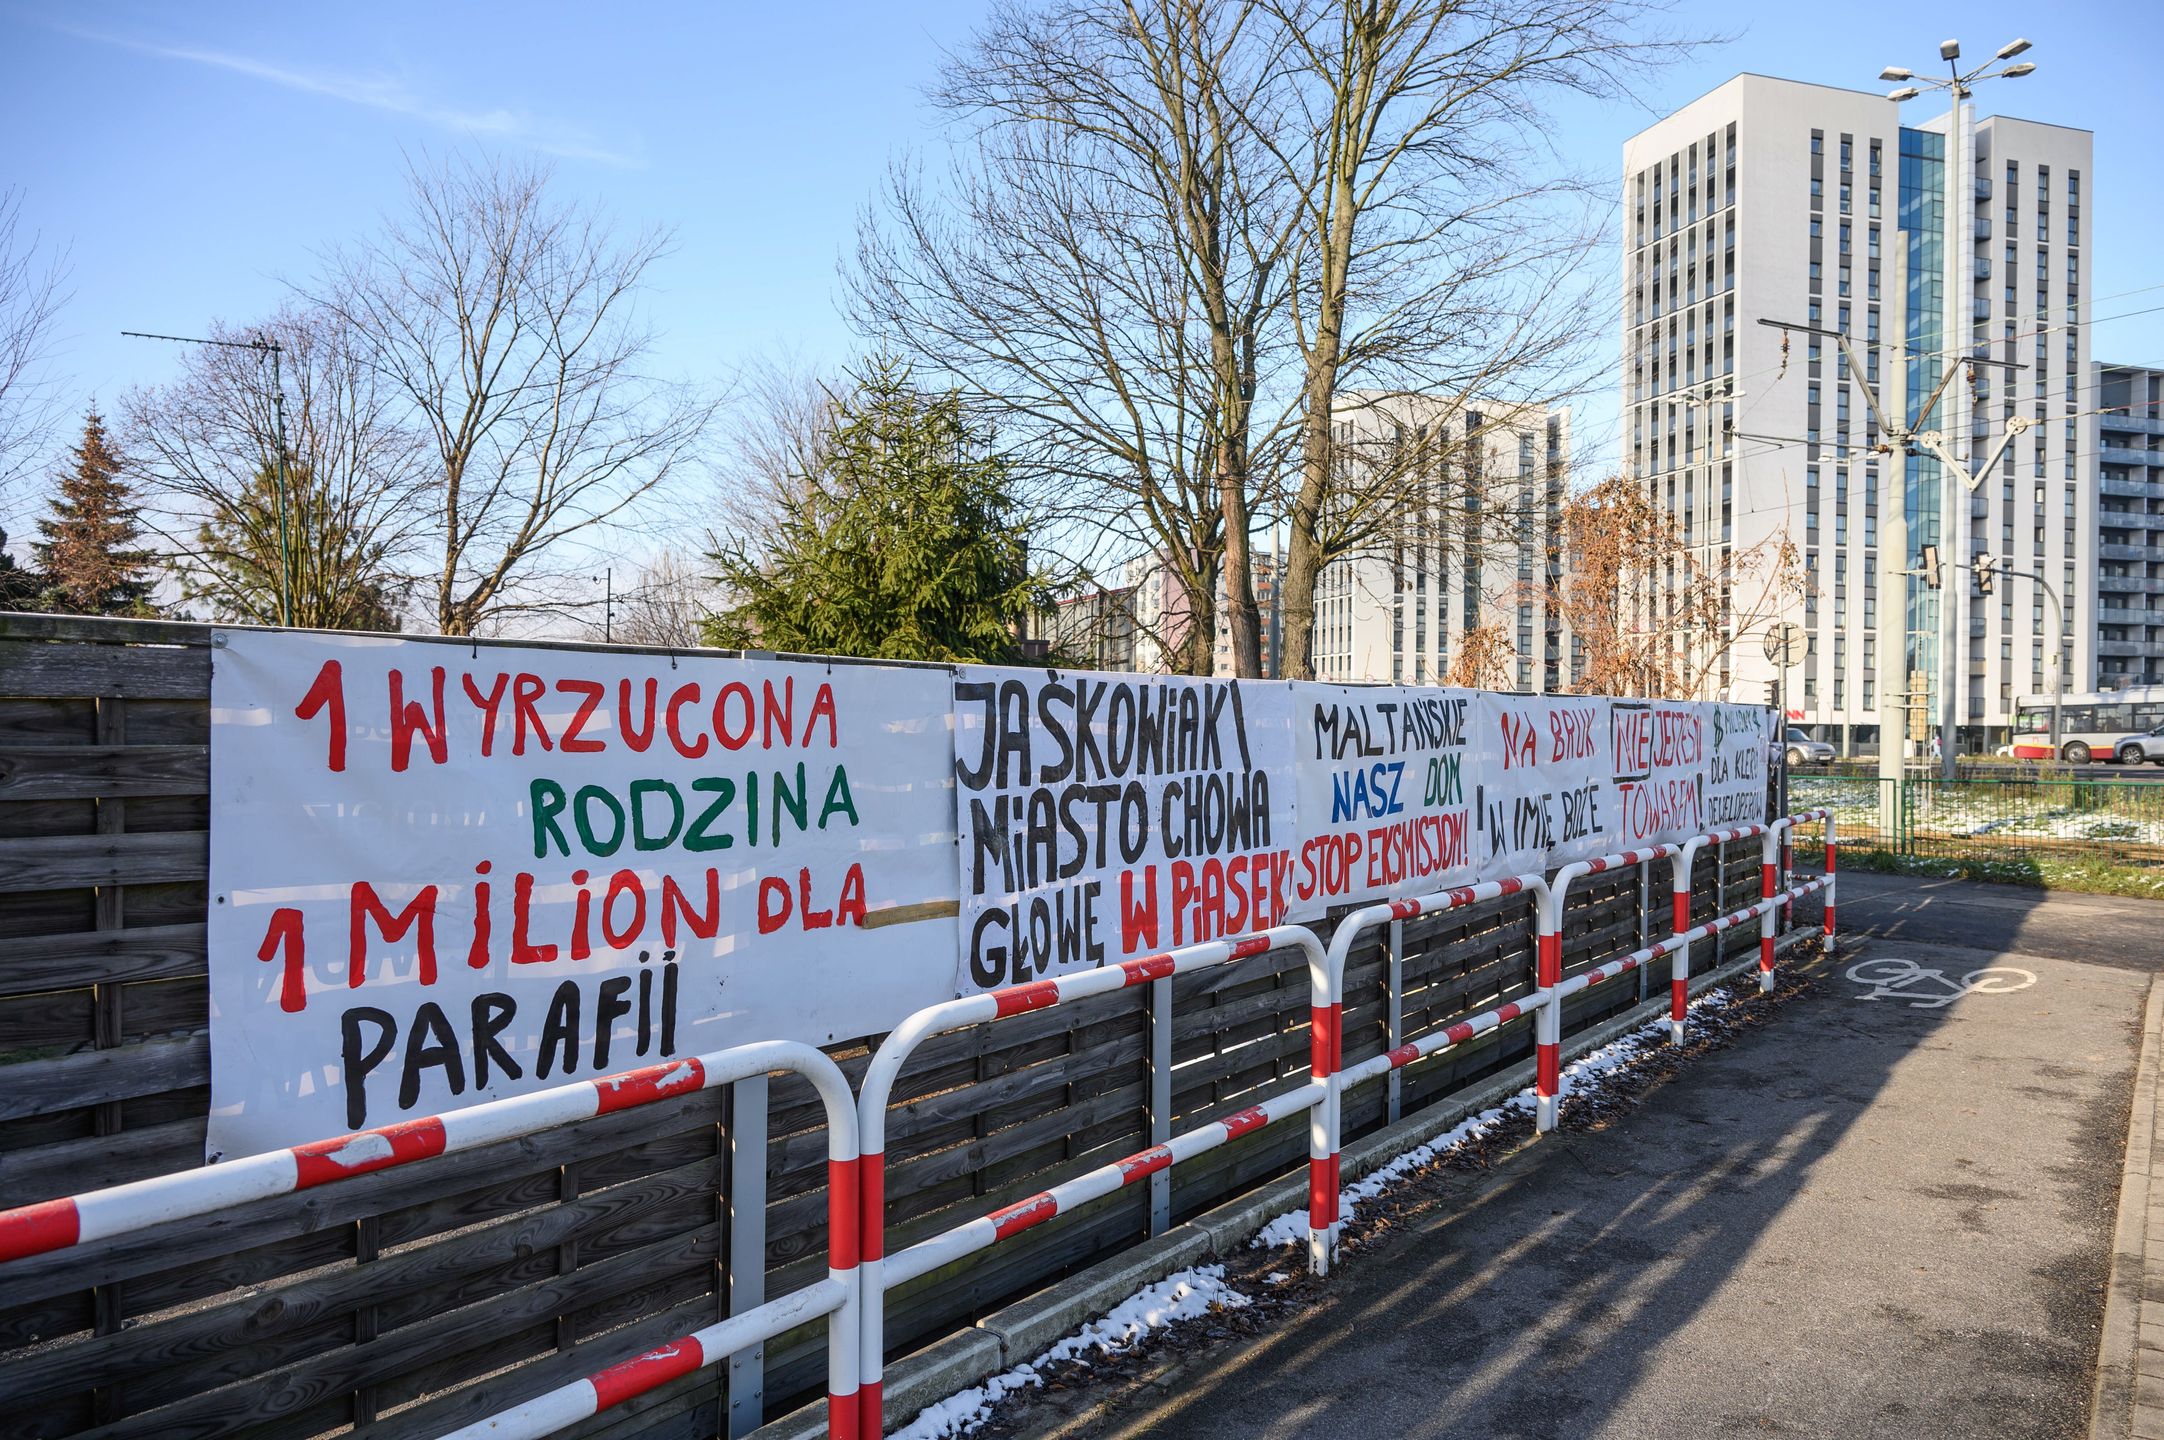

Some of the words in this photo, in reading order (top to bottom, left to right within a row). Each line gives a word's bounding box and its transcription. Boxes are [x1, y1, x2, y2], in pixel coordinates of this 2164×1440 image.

[295, 660, 346, 772] 1
[389, 666, 838, 773] WYRZUCONA
[1314, 698, 1467, 760] MALTAŃSKIE
[1501, 711, 1536, 770] NA
[1549, 708, 1596, 763] BRUK
[1615, 712, 1650, 773] NIE
[530, 761, 859, 859] RODZINA
[1331, 761, 1406, 824] NASZ
[1423, 752, 1463, 808] DOM
[1711, 756, 1729, 785] DLA
[1161, 769, 1271, 859] CHOWA
[1296, 832, 1363, 901] STOP
[1366, 808, 1469, 889] EKSMISJOM!
[1489, 800, 1507, 858] W
[257, 908, 306, 1013] 1
[758, 862, 868, 934] DLA
[970, 881, 1104, 988] GŁOWĘ
[1120, 865, 1158, 954] W
